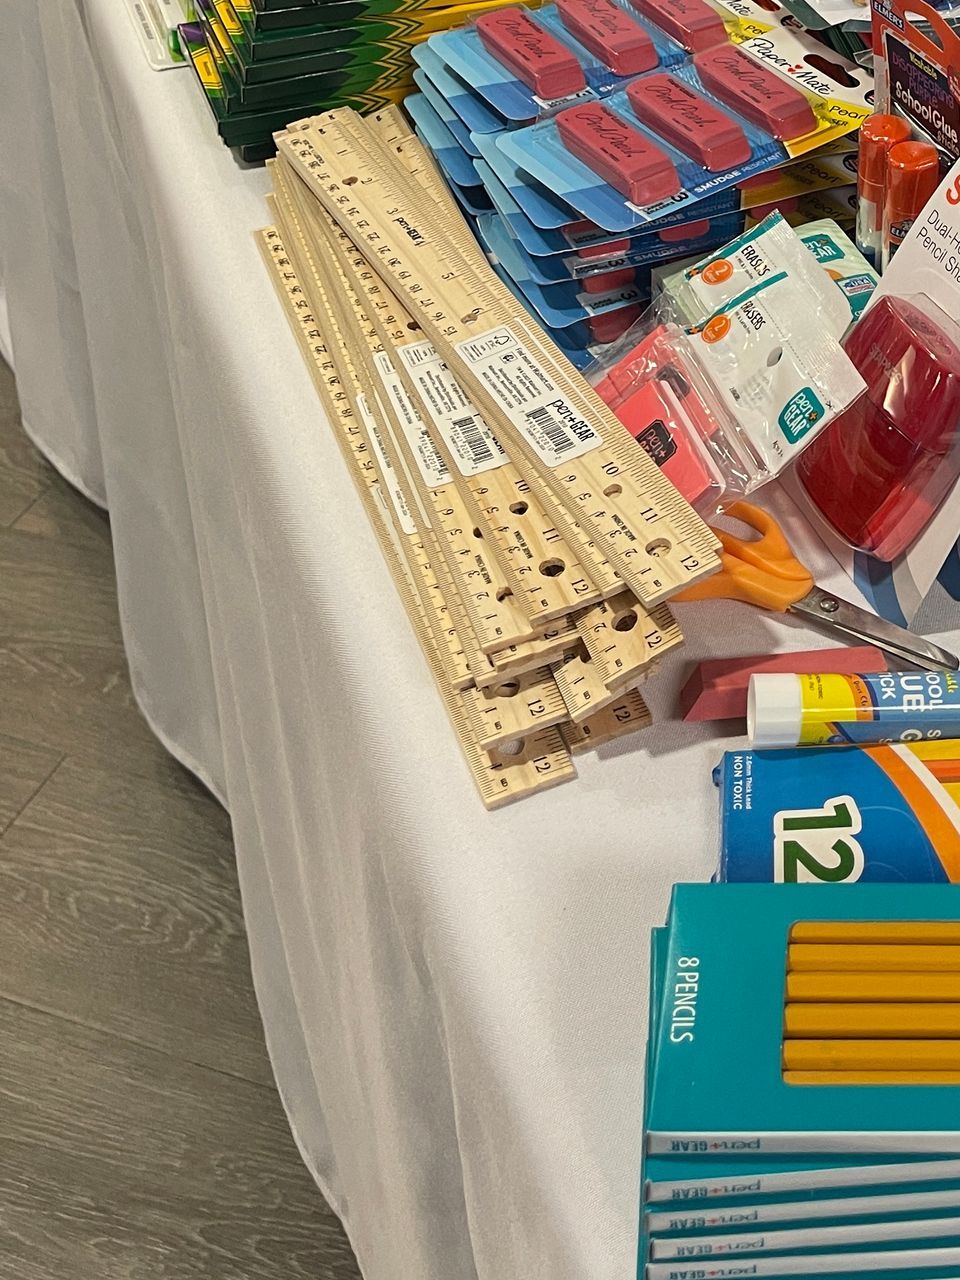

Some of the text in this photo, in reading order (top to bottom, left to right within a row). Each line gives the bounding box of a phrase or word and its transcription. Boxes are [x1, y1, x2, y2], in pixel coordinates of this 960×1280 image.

[874, 2, 903, 29] ELMER'S
[749, 38, 831, 95] Paper Mate
[909, 52, 937, 80] Washable
[895, 81, 958, 143] School Glue
[937, 131, 959, 155] Sticks
[693, 168, 742, 195] SMUDGE
[916, 227, 944, 262] Pencil
[714, 266, 728, 275] 2
[714, 322, 727, 334] 2
[741, 300, 766, 331] ERASERS
[783, 404, 805, 436] GEAR
[792, 393, 817, 420] pen+
[546, 399, 595, 442] pen+GEAR
[602, 462, 619, 476] 10
[640, 508, 658, 521] 11
[681, 555, 699, 571] 12
[571, 579, 589, 594] 12
[645, 629, 663, 648] 12
[733, 756, 743, 809] NON TOXIC
[670, 956, 700, 1043] 8 PENCILS
[671, 1138, 761, 1152] pen+GEAR
